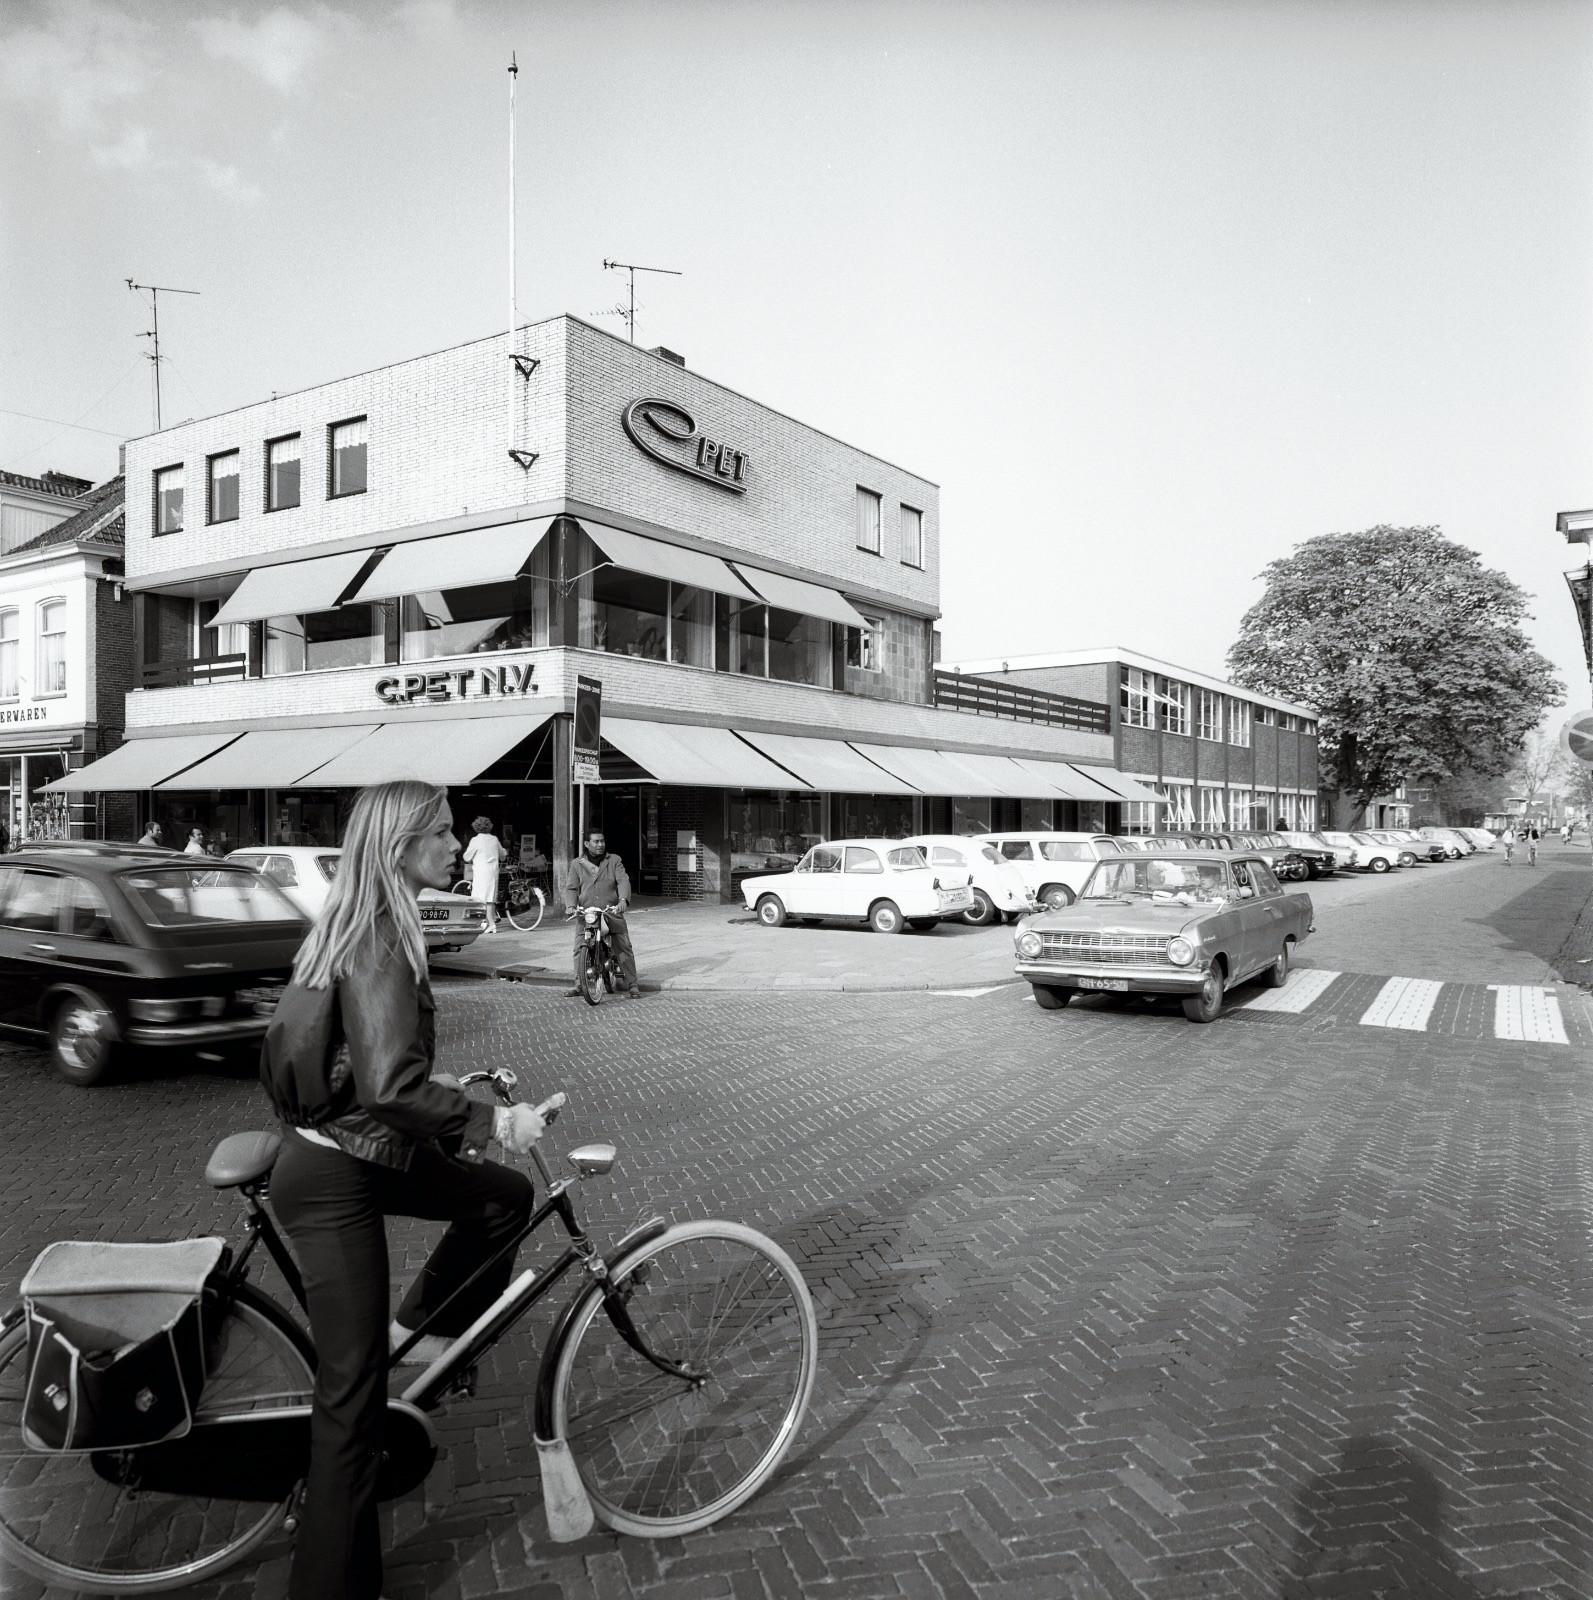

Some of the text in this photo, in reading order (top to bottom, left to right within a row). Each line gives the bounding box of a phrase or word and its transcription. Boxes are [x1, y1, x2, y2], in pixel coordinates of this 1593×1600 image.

[696, 437, 750, 480] PET
[375, 664, 539, 704] C.PET N.V.
[0, 707, 46, 722] ERWAREN
